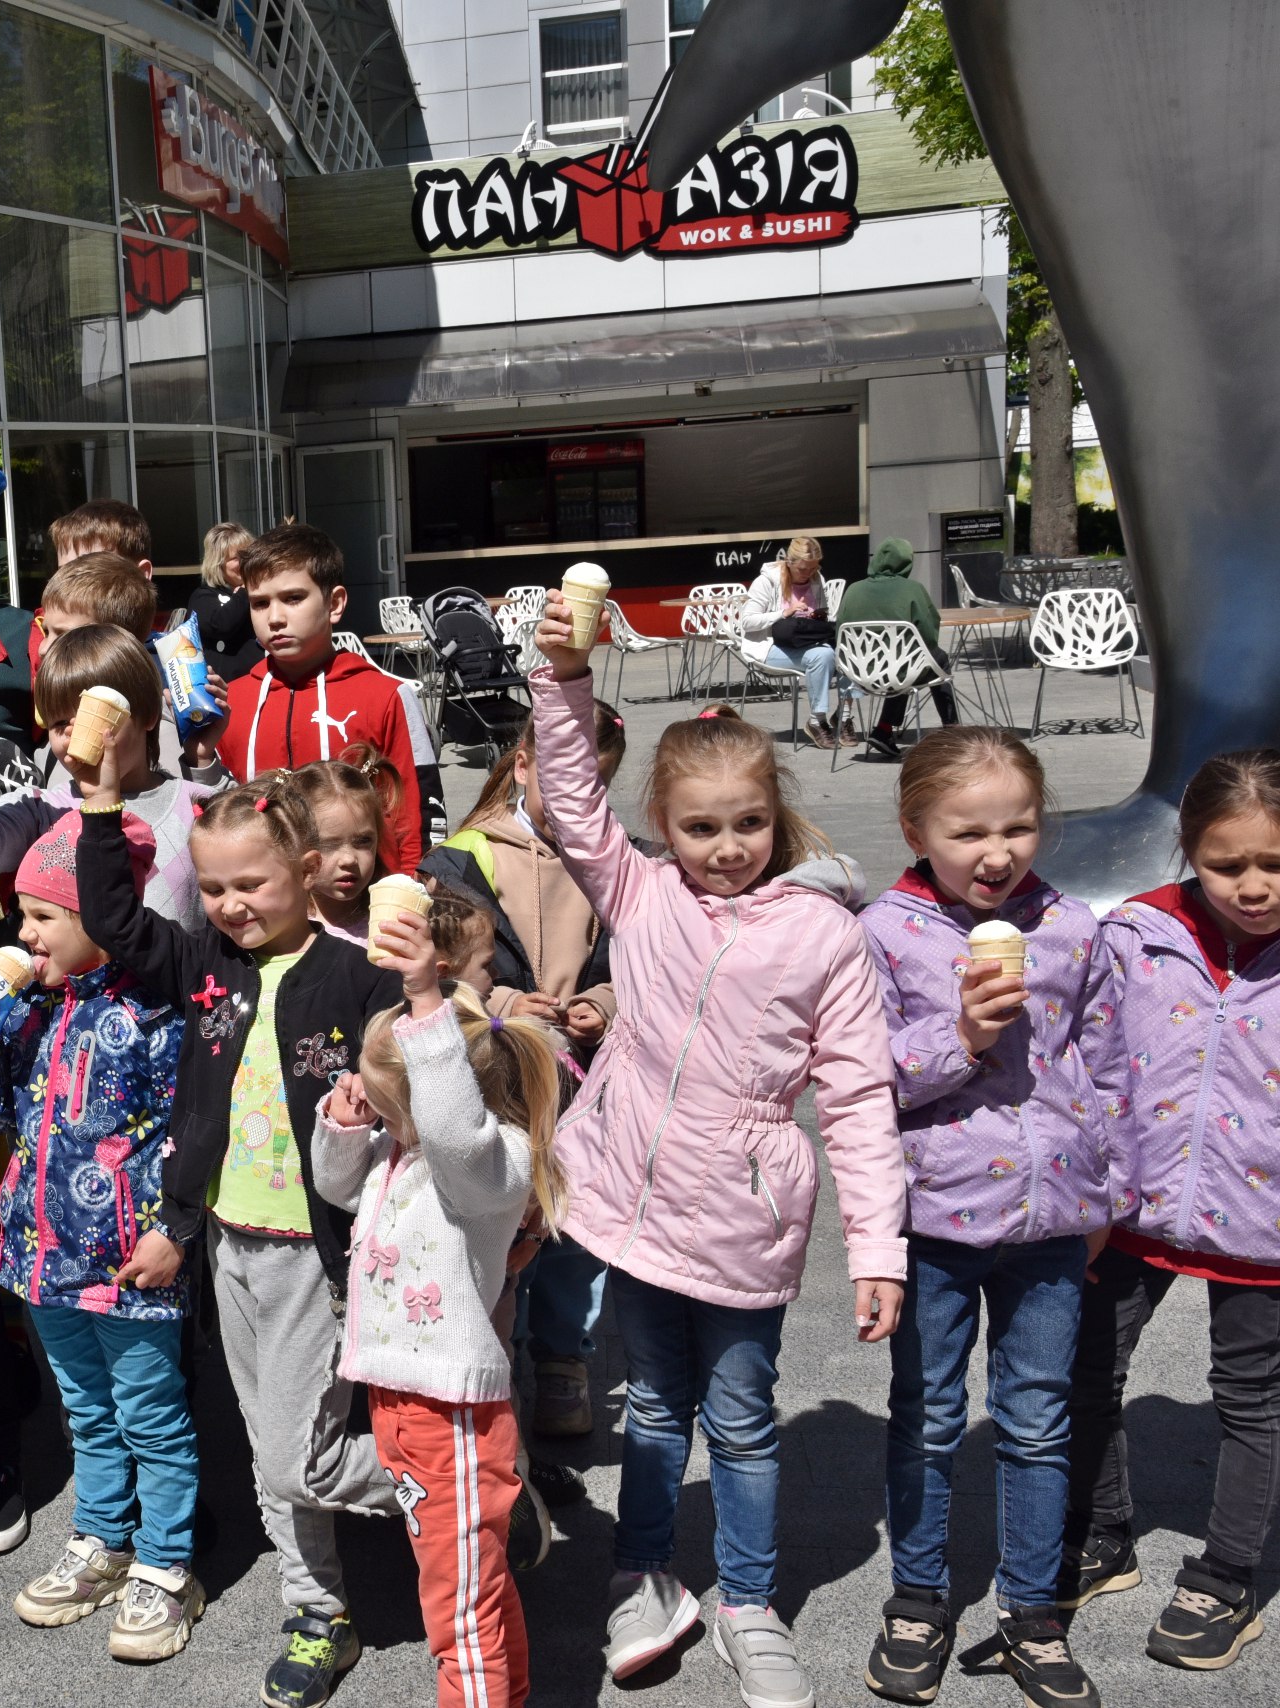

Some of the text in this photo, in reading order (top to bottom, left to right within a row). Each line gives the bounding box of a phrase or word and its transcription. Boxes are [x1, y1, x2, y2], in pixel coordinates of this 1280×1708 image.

[422, 136, 848, 242] ПАН АЗІЯ
[680, 215, 832, 246] WOK & SUSHI
[715, 550, 752, 567] ПАН
[168, 660, 187, 707] ХРЕЩАТИК
[294, 1033, 349, 1078] Love
